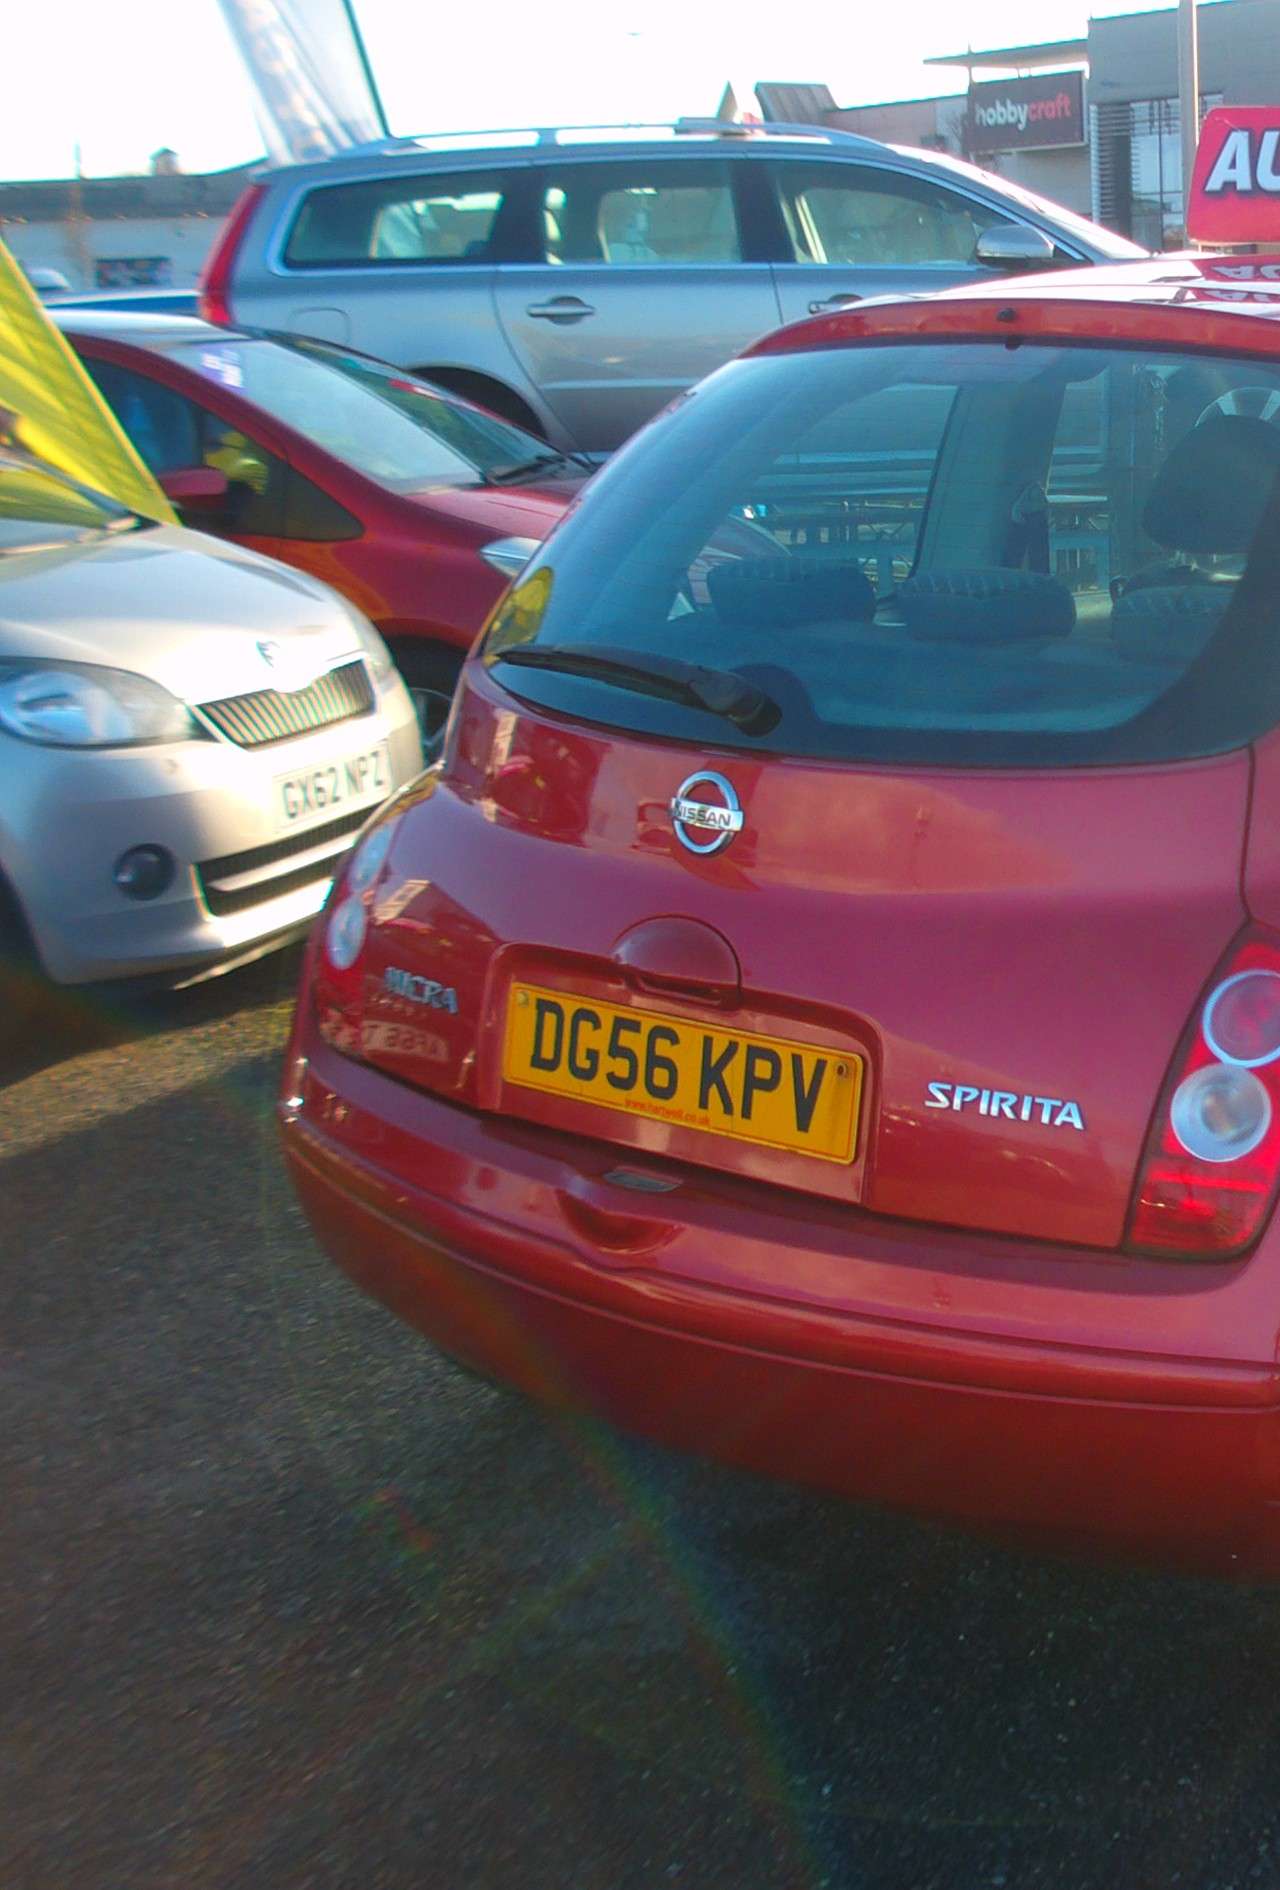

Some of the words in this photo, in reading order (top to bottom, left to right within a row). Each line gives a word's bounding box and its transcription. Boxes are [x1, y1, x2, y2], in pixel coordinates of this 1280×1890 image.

[975, 93, 1072, 130] hobbycraft
[282, 767, 341, 819] GX62
[674, 803, 732, 827] NISSAN
[530, 997, 680, 1101] DG56
[698, 1034, 828, 1134] KPV
[924, 1081, 1084, 1130] SPIRITA
